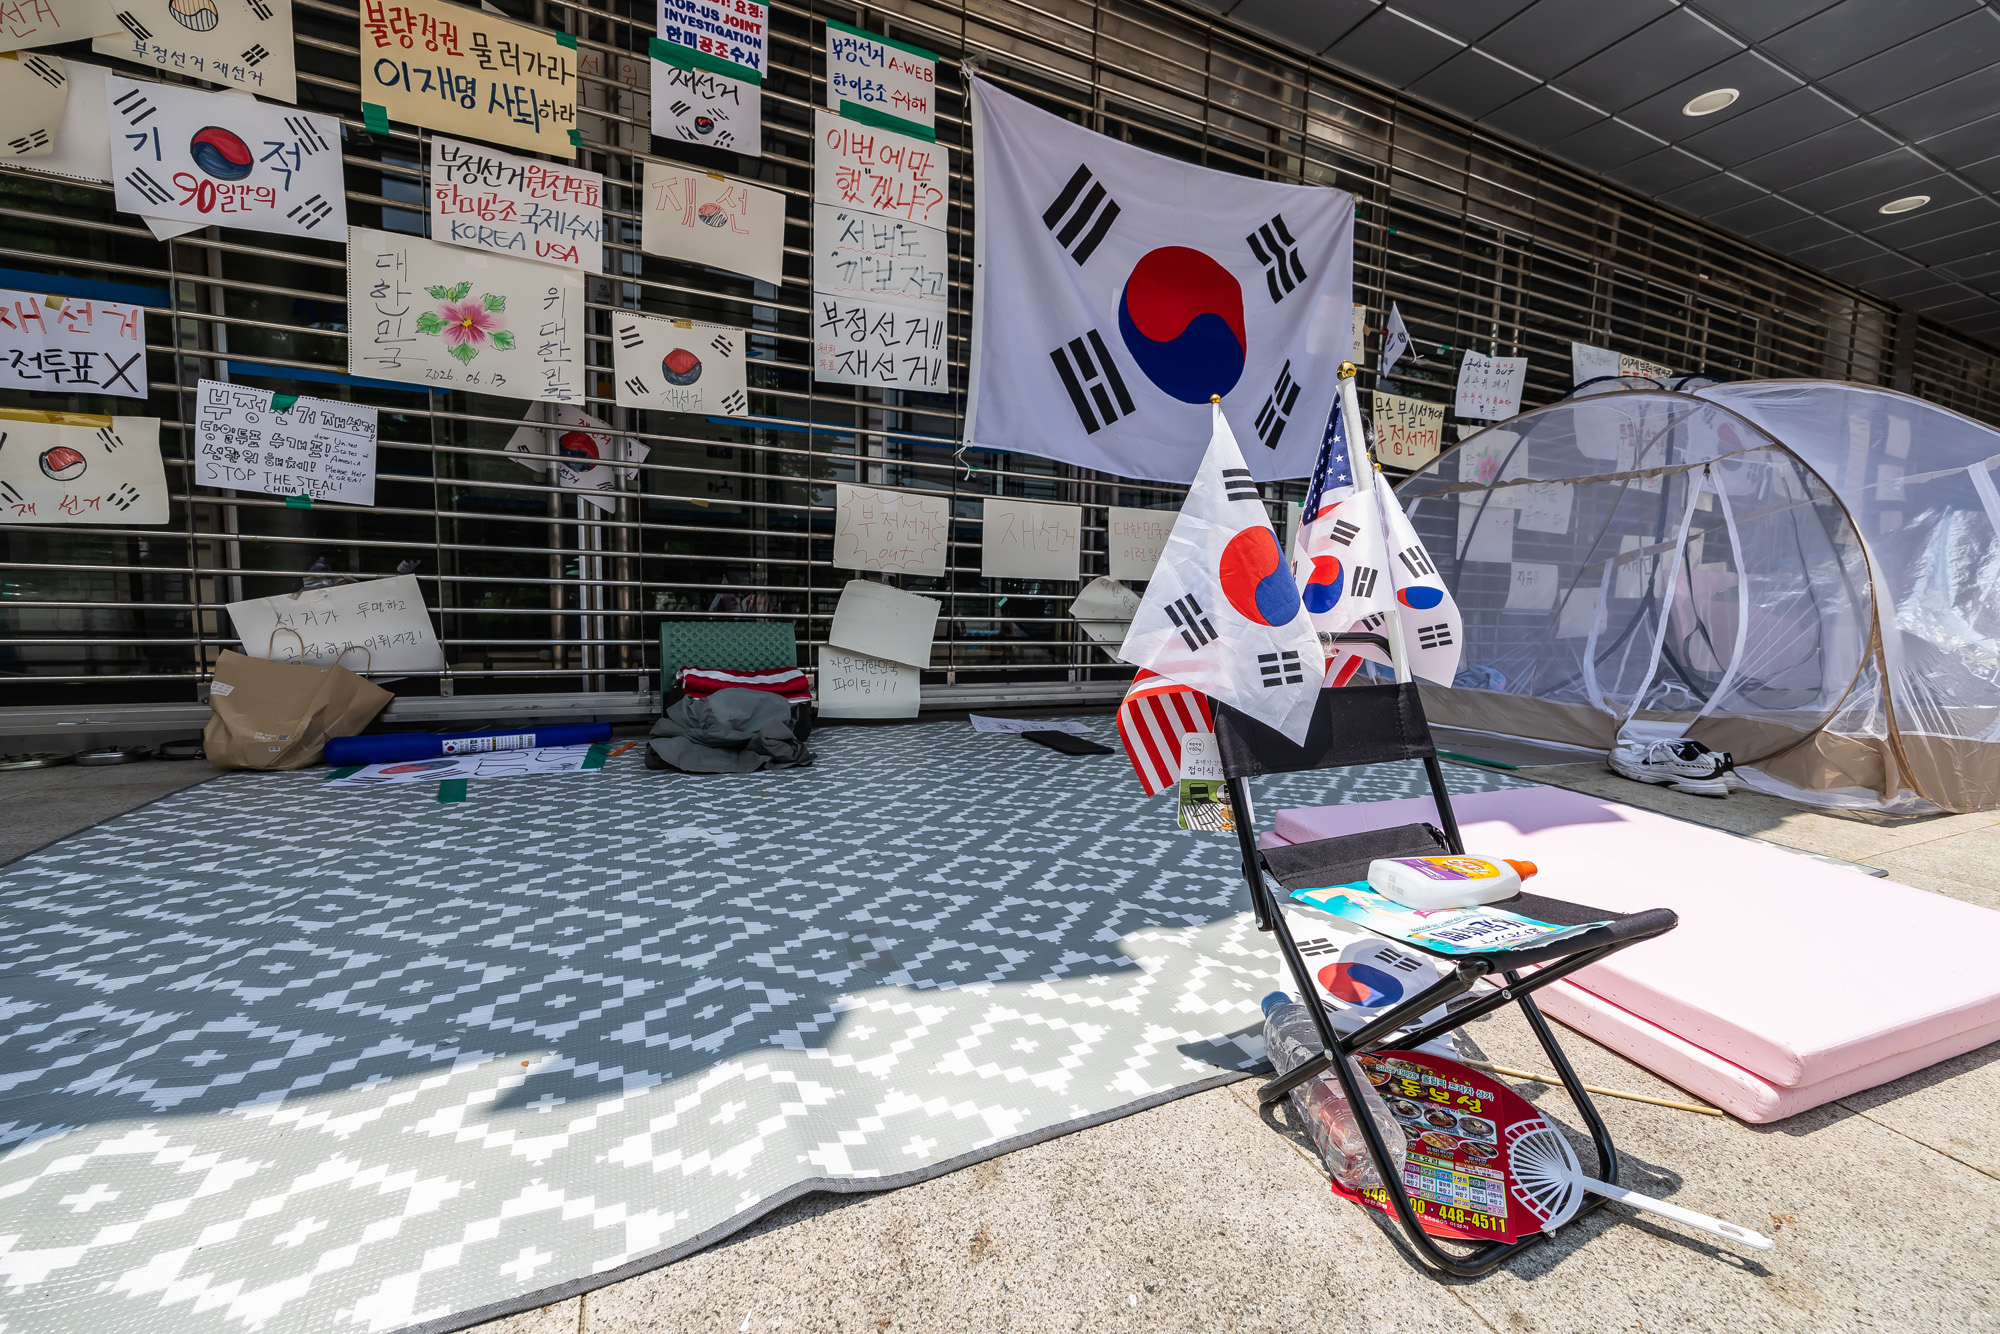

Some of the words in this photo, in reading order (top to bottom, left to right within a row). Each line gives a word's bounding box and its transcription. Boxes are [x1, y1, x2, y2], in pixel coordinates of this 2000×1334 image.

[664, 0, 720, 21] KOR-US
[722, 13, 762, 35] JOINT
[364, 0, 465, 57] 불량정권
[469, 32, 576, 85] 물러가라
[832, 37, 885, 68] 부정선거
[888, 56, 934, 83] A-WEB
[132, 40, 204, 72] 부정선거
[212, 60, 265, 87] 재선거
[373, 58, 477, 109] 이재명
[488, 82, 576, 133] 사퇴하라
[667, 67, 740, 106] 재선거
[125, 126, 162, 162] 기
[259, 140, 302, 192] 적
[451, 219, 526, 251] KOREA
[535, 239, 579, 264] USA
[660, 387, 704, 414] 재선거
[205, 462, 257, 482] STOP
[263, 471, 291, 486] THE
[296, 474, 343, 493] STEAL!
[263, 484, 297, 495] CHINA
[302, 487, 326, 499] LEE!
[999, 512, 1077, 551] 재선거
[1188, 766, 1214, 776] 접이식
[1376, 1064, 1396, 1074] Since
[1400, 1077, 1483, 1114] 동보성
[1438, 1205, 1506, 1233] 448-4511
